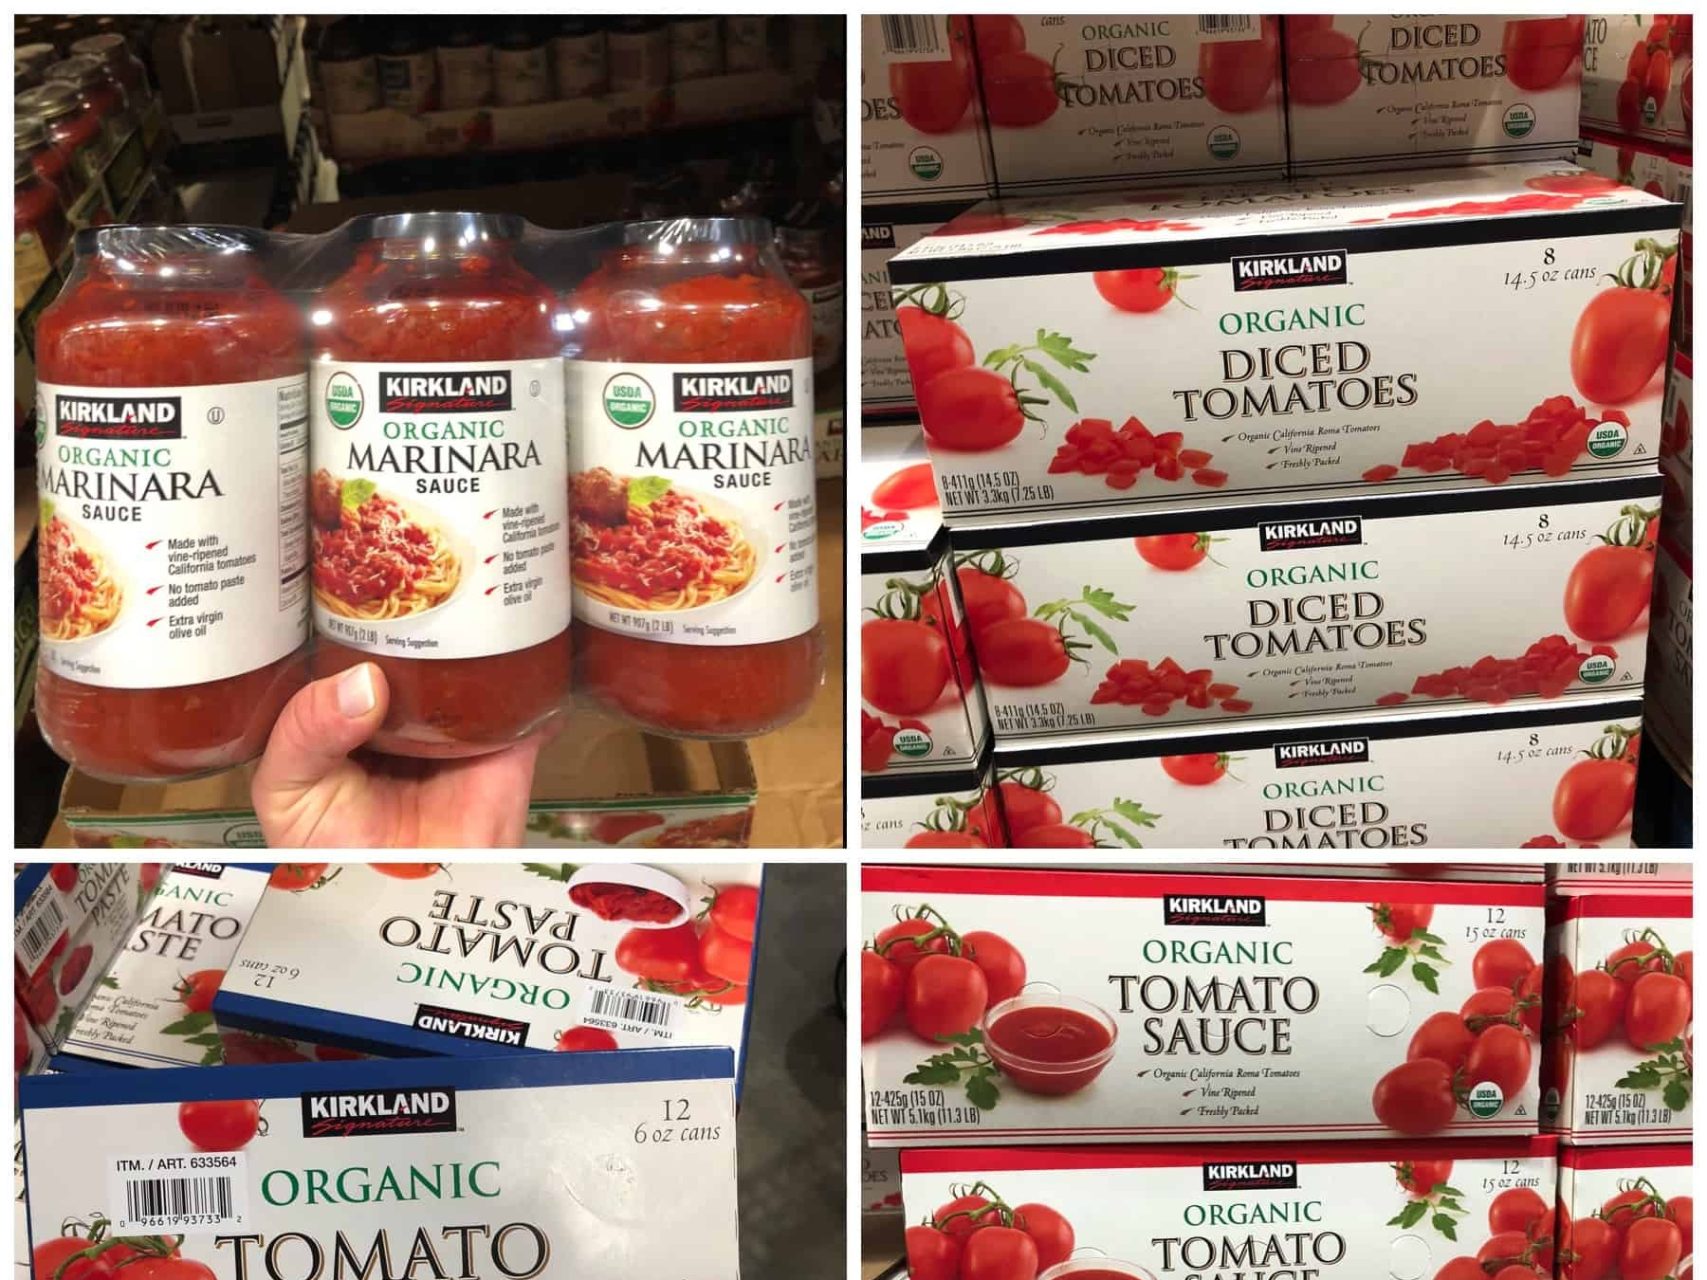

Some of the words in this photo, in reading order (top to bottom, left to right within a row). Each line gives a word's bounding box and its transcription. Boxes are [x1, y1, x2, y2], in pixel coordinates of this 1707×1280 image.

[1082, 21, 1169, 40] ORGANIC
[1392, 24, 1481, 50] DICED
[1086, 46, 1176, 72] DICED
[1366, 54, 1508, 86] TOMATOES
[1063, 77, 1206, 108] TOMATOES
[1239, 255, 1343, 278] KIRKLAND
[1544, 247, 1555, 265] 8
[1505, 271, 1538, 290] 14.5
[1542, 270, 1559, 282] oz
[1564, 267, 1596, 280] cans
[1219, 304, 1366, 335] ORGANIC
[1221, 341, 1371, 383] DICED
[386, 376, 508, 397] KIRKLAND
[681, 375, 791, 397] KIRKLAND
[1173, 373, 1418, 422] TOMATOES
[60, 401, 175, 423] KIRKLAND
[384, 420, 505, 440] ORGANIC
[678, 417, 789, 438] ORGANIC
[1238, 434, 1271, 443] Organic
[1272, 429, 1315, 442] California
[1597, 430, 1619, 439] USDA
[58, 445, 171, 467] ORGANIC
[347, 440, 542, 474] MARINARA
[635, 435, 811, 470] MARINARA
[416, 478, 480, 493] SAUCE
[714, 472, 771, 489] SAUCE
[946, 491, 963, 506] NET
[964, 491, 980, 504] WT
[1037, 485, 1054, 500] LB)
[82, 504, 142, 521] SAUCE
[1539, 514, 1550, 529] 8
[1265, 521, 1357, 540] KIRKLAND
[1503, 533, 1532, 549] 14.5
[1537, 531, 1552, 543] oz
[1557, 528, 1586, 540] cans
[168, 539, 195, 549] Made
[198, 535, 219, 547] with
[168, 546, 228, 562] vine-ripened
[168, 561, 214, 575] California
[217, 554, 256, 570] tomatoes
[169, 584, 182, 594] No
[185, 580, 218, 593] tomato
[221, 576, 245, 590] paste
[1247, 561, 1379, 588] ORGANIC
[169, 594, 199, 607] added
[1249, 592, 1384, 628] DICED
[169, 615, 194, 627] Extra
[197, 611, 223, 624] virgin
[169, 628, 192, 639] olive
[195, 625, 206, 637] oil
[1203, 618, 1427, 661] TOMATOES
[1280, 741, 1365, 759] KIRKLAND
[1263, 776, 1384, 800] ORGANIC
[1264, 802, 1388, 834] DICED
[428, 889, 580, 942] PASTE
[1169, 898, 1261, 914] KIRKLAND
[1488, 908, 1505, 923] 12
[1466, 927, 1479, 943] 15
[1482, 928, 1497, 938] oz
[1500, 928, 1526, 938] cans
[379, 916, 613, 983] TOMATO
[1143, 940, 1293, 965] ORGANIC
[396, 962, 571, 1010] ORGANIC
[1109, 975, 1320, 1014] TOMATO
[418, 1016, 521, 1044] KIRKLAND
[1143, 1018, 1292, 1056] SAUCE
[311, 1092, 449, 1119] KIRKLAND
[663, 1098, 691, 1121] 12
[871, 1090, 908, 1108] 12-425g
[911, 1090, 926, 1108] (15
[928, 1090, 944, 1107] OZ)
[871, 1109, 888, 1124] NET
[890, 1109, 905, 1124] WT
[908, 1108, 935, 1125] 5.1kg
[938, 1108, 961, 1125] (11.3
[964, 1107, 980, 1125] LB)
[634, 1121, 647, 1143] 6
[652, 1129, 673, 1142] oz
[681, 1126, 720, 1141] cans
[117, 1160, 144, 1171] ITM.
[148, 1159, 154, 1170] /
[157, 1158, 186, 1169] ART.
[190, 1156, 236, 1168] 633564
[1209, 1164, 1294, 1179] KIRKLAND
[261, 1161, 501, 1207] ORGANIC
[1184, 1201, 1322, 1226] ORGANIC
[1151, 1232, 1346, 1271] TOMATO
